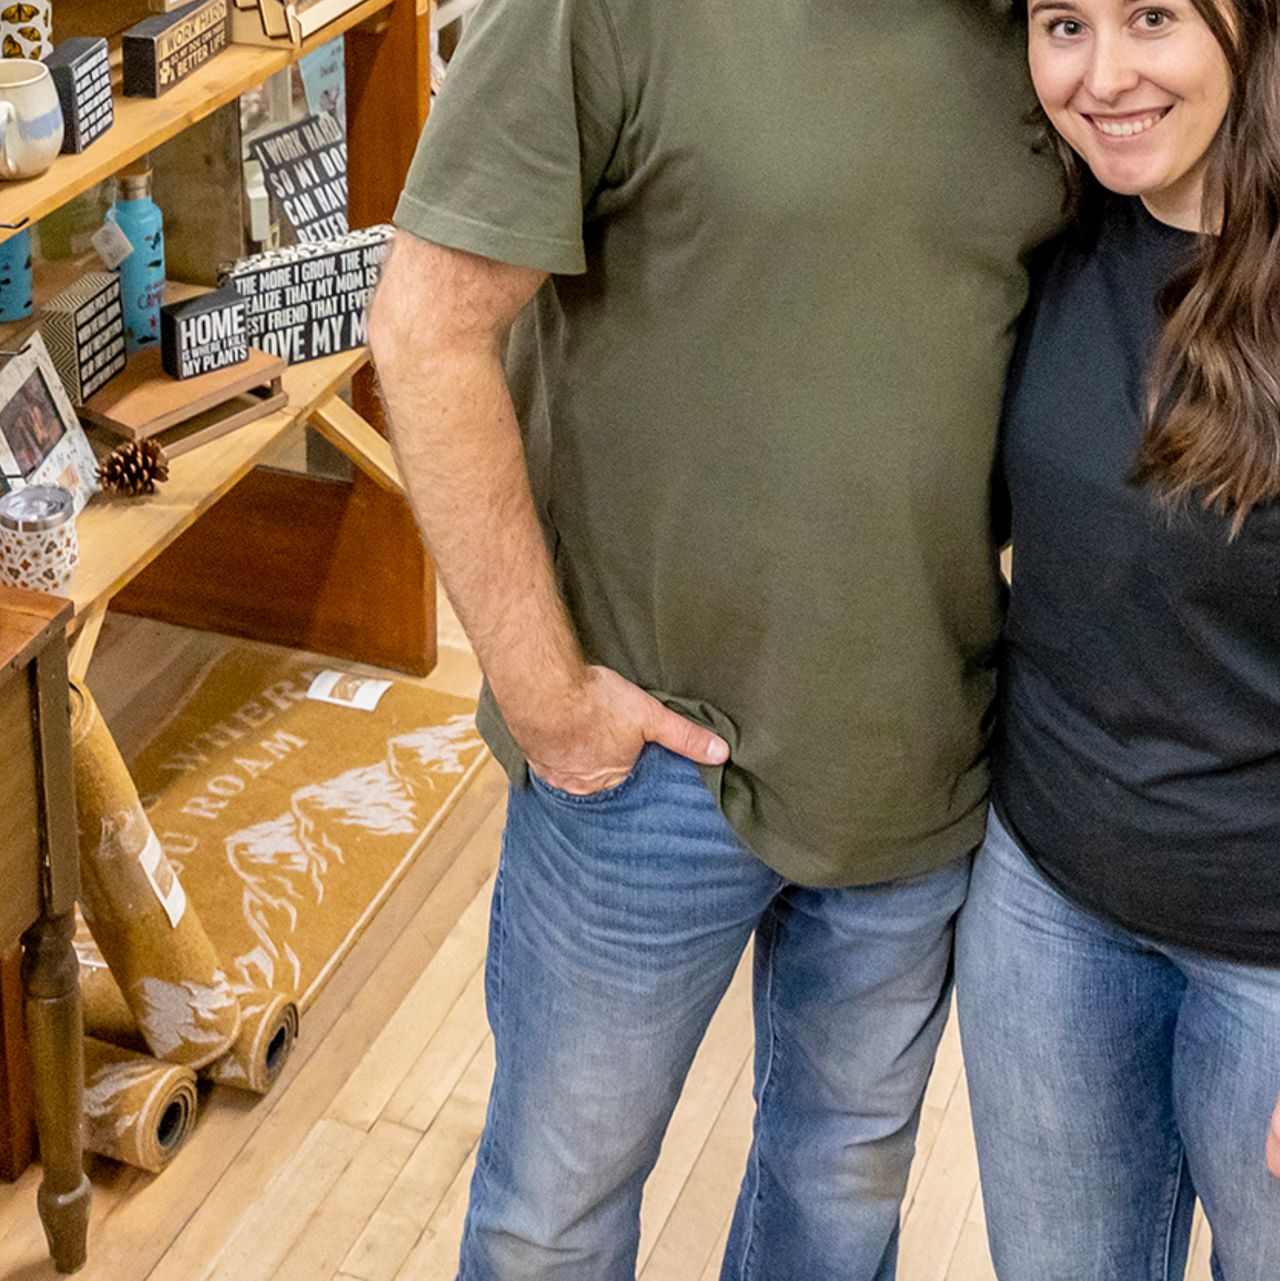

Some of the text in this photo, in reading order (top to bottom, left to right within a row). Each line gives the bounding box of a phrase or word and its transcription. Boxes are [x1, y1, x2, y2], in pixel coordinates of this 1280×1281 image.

[167, 23, 196, 54] WORK
[199, 2, 225, 28] HARD
[176, 44, 209, 78] BETTER
[209, 29, 226, 53] LIFE
[254, 110, 343, 170] I WORK HARD
[269, 168, 296, 199] SO
[292, 157, 320, 189] MY
[283, 176, 349, 227] CAN HAV
[236, 275, 257, 296] THE
[259, 267, 293, 293] MORE
[294, 264, 299, 282] I
[341, 250, 361, 271] THE
[362, 243, 389, 267] MOR
[246, 267, 379, 315] EALIZE THAT MY MOM IS
[180, 303, 247, 350] HOME
[247, 313, 266, 336] EST
[268, 303, 309, 331] FRIEND
[310, 296, 339, 320] THAT
[340, 293, 346, 313] I
[312, 315, 345, 358] MY
[350, 310, 369, 348] M
[182, 345, 247, 377] MY PLANTS
[191, 340, 220, 358] WHERE
[228, 333, 247, 348] KILL
[159, 670, 318, 771] WHER
[181, 729, 308, 820] ROAM
